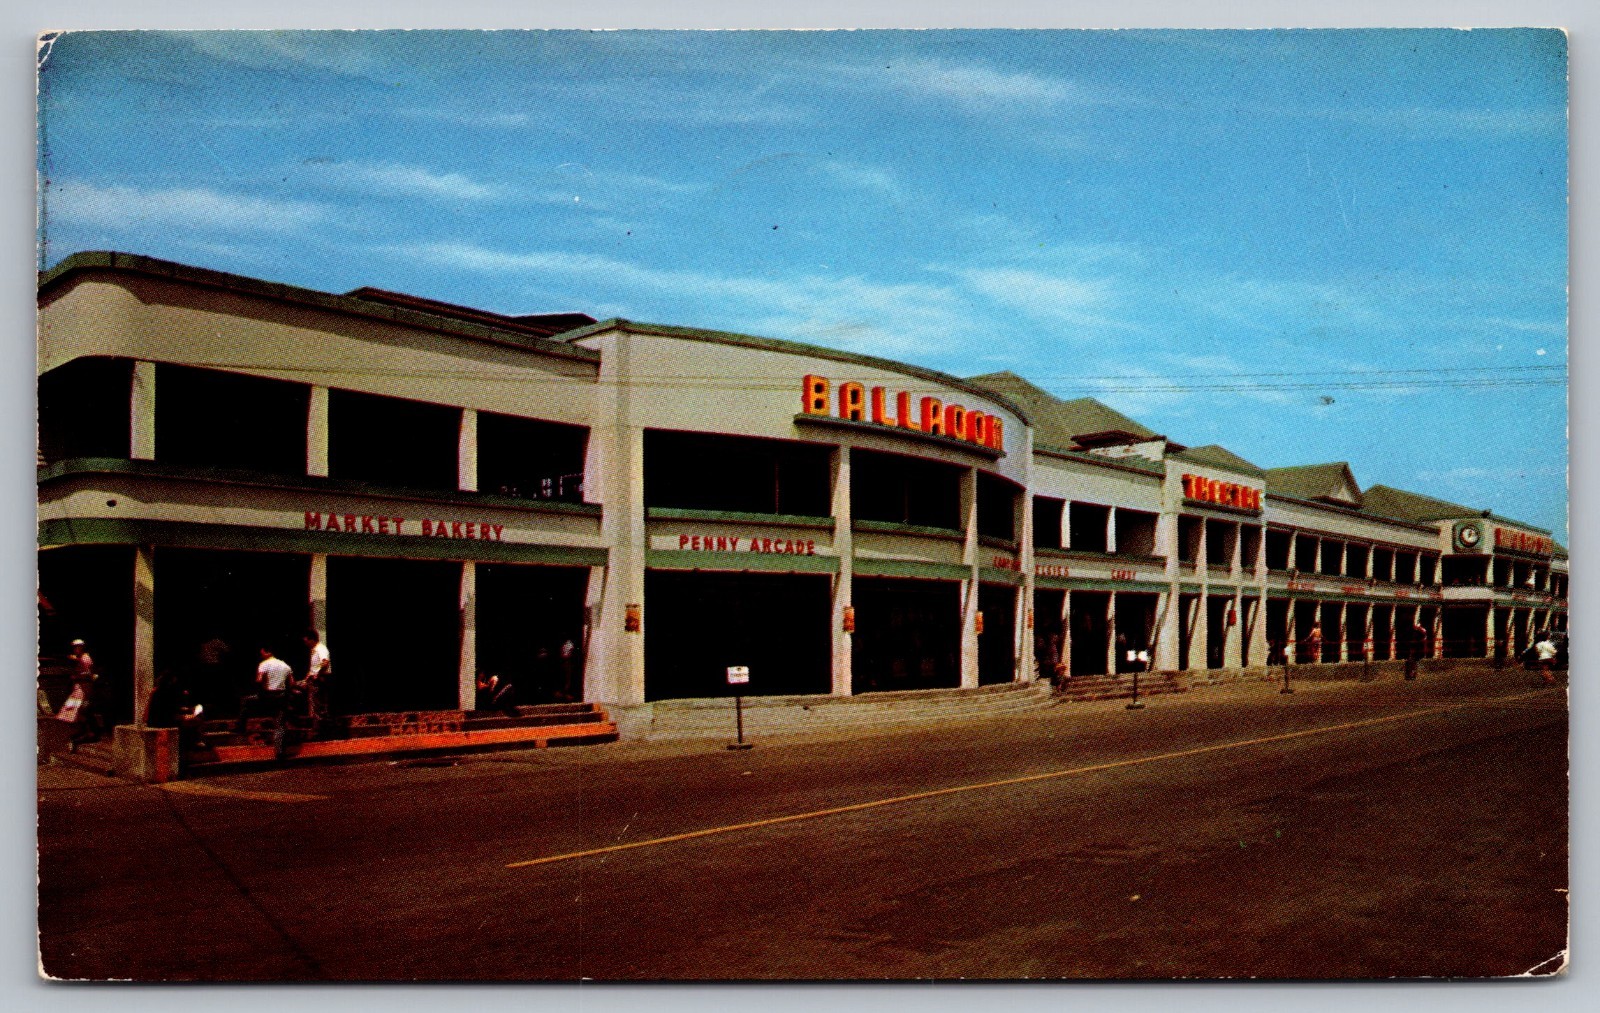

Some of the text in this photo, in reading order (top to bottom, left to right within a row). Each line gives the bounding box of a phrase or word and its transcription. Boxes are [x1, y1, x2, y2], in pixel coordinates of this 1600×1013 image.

[802, 374, 1004, 452] BALLROOM
[304, 511, 504, 542] MARKET BAKERY
[679, 534, 816, 556] PENNY ARCADE
